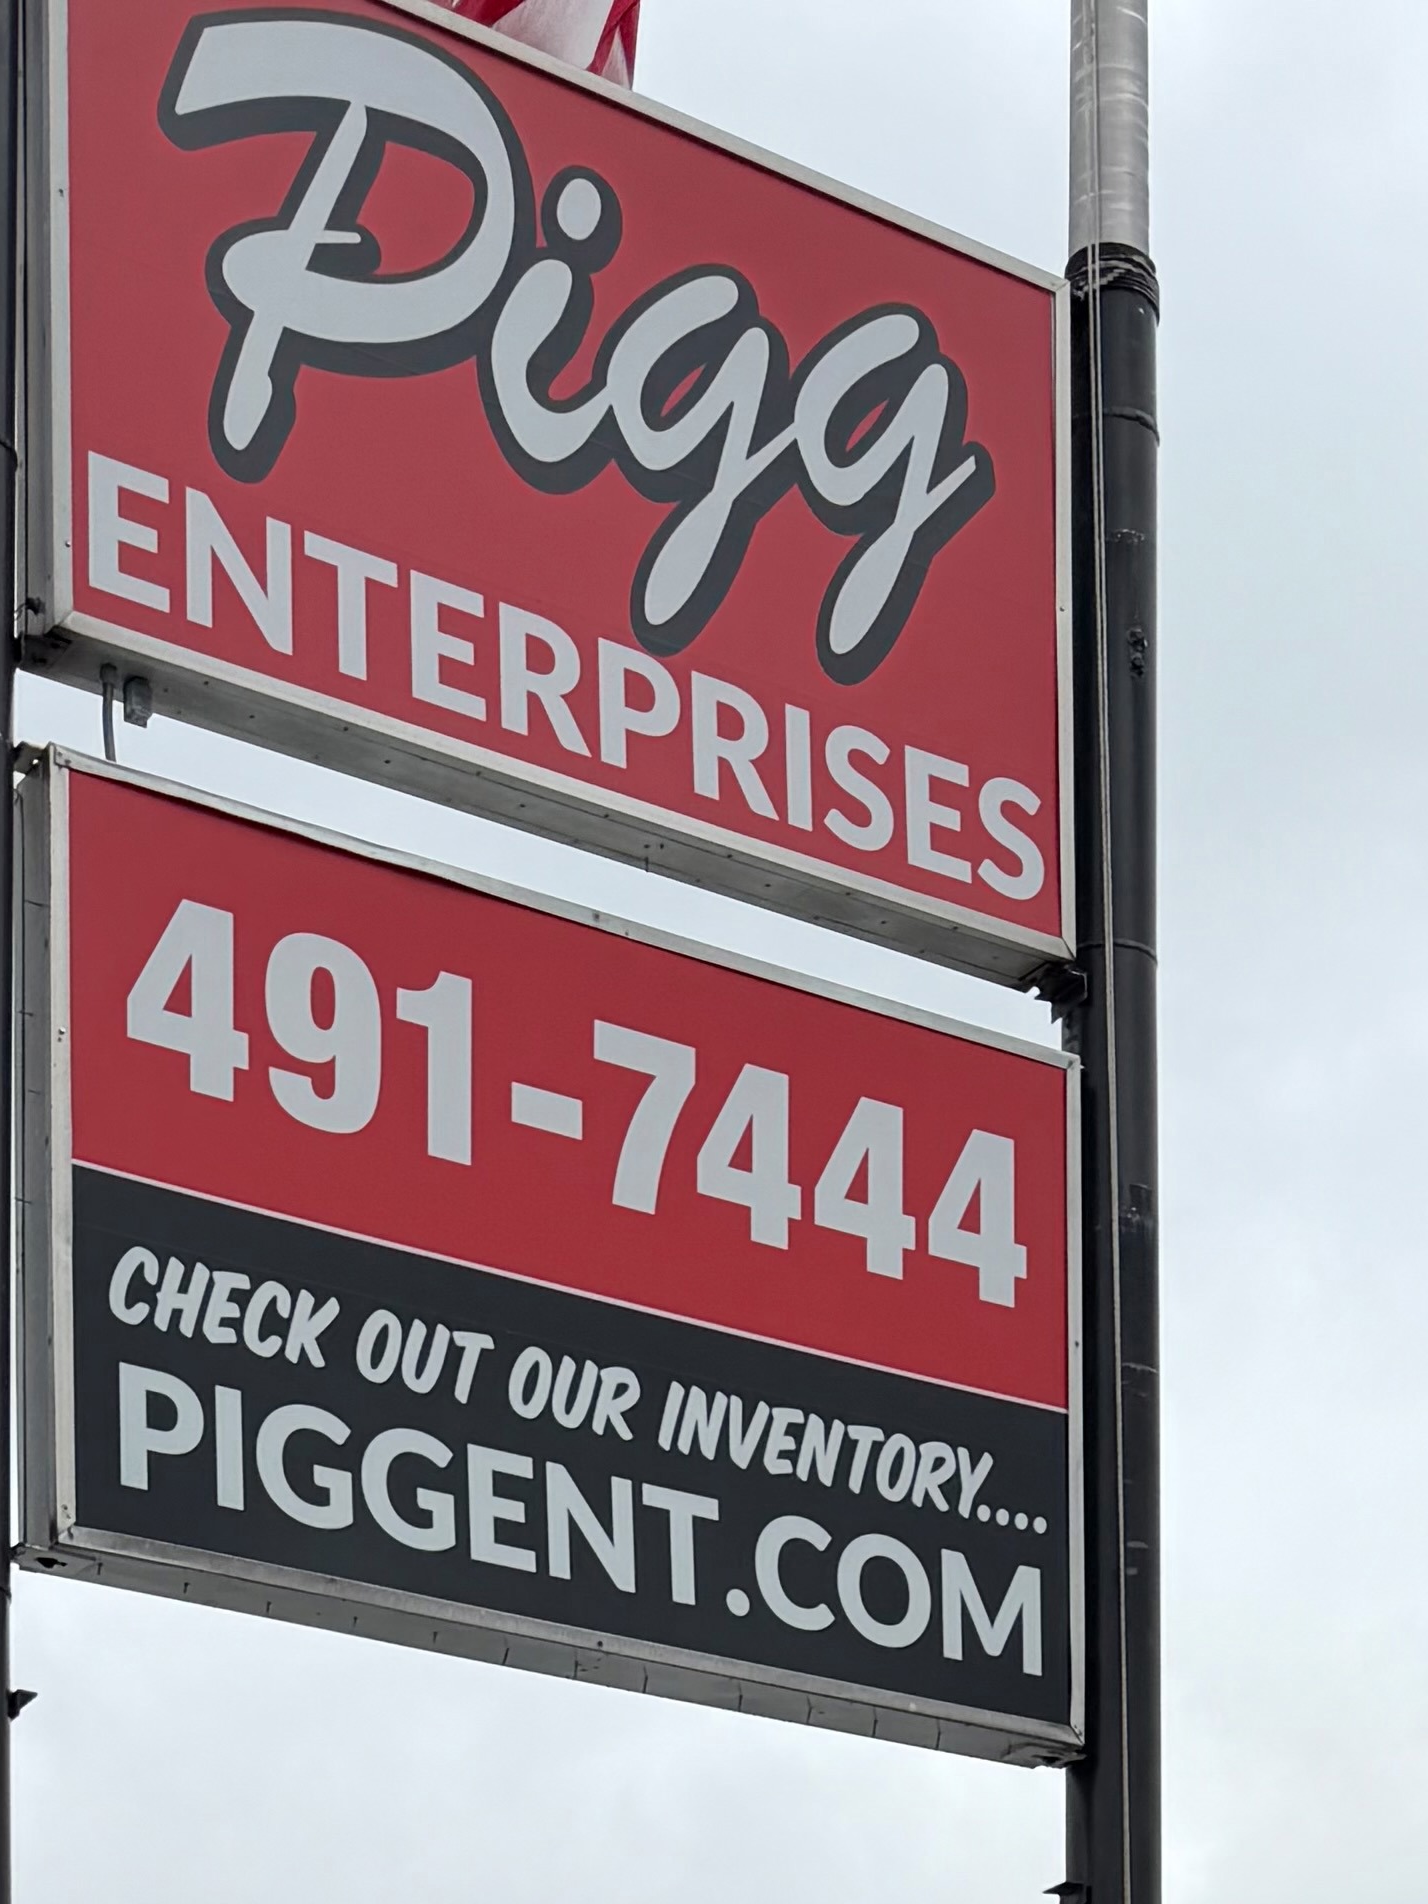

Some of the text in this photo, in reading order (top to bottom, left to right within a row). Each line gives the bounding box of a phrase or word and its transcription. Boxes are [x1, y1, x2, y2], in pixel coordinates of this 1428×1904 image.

[166, 14, 986, 670] Pigg
[87, 450, 1046, 902] ENTERPRISES
[126, 898, 1028, 1308] 491-7444
[109, 1245, 340, 1369] CHECK
[356, 1308, 495, 1406] OUT
[507, 1343, 642, 1442] OUR
[117, 1361, 1045, 1677] PIGGENT.COM
